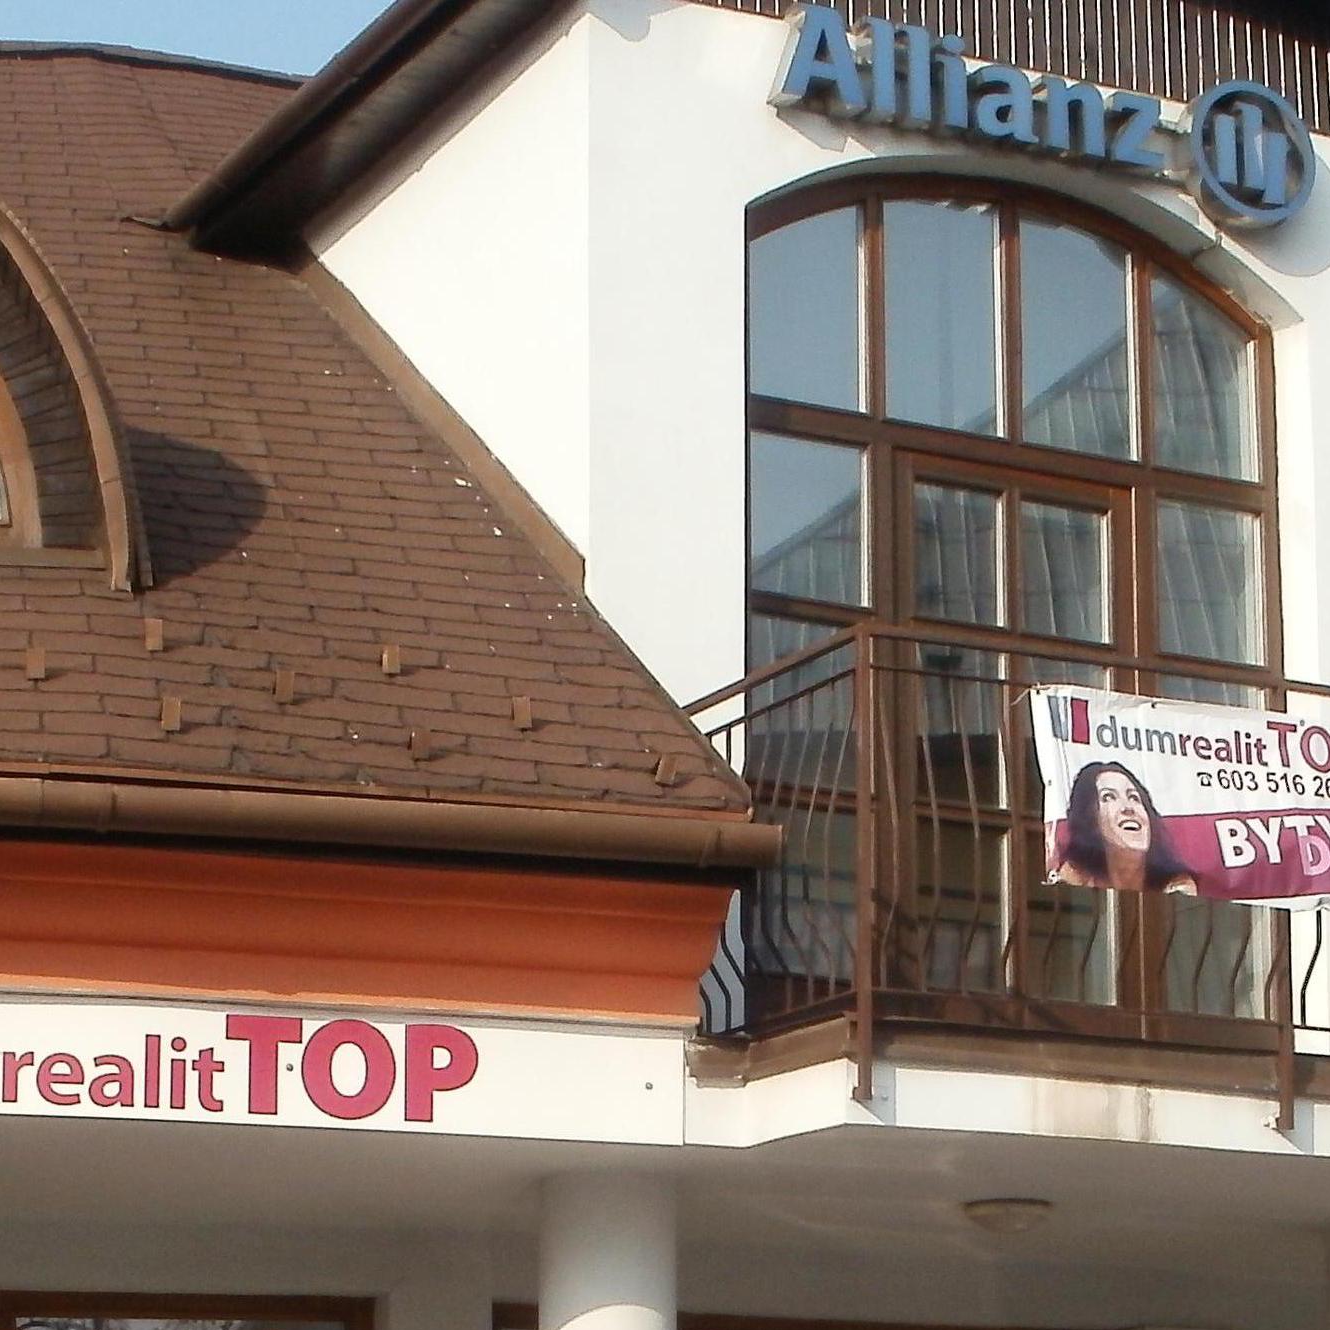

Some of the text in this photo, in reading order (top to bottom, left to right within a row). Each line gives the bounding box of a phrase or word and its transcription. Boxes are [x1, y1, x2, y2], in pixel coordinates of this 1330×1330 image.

[776, 3, 1164, 168] Allianz
[1217, 769, 1259, 793] 603
[1267, 771, 1305, 796] 516
